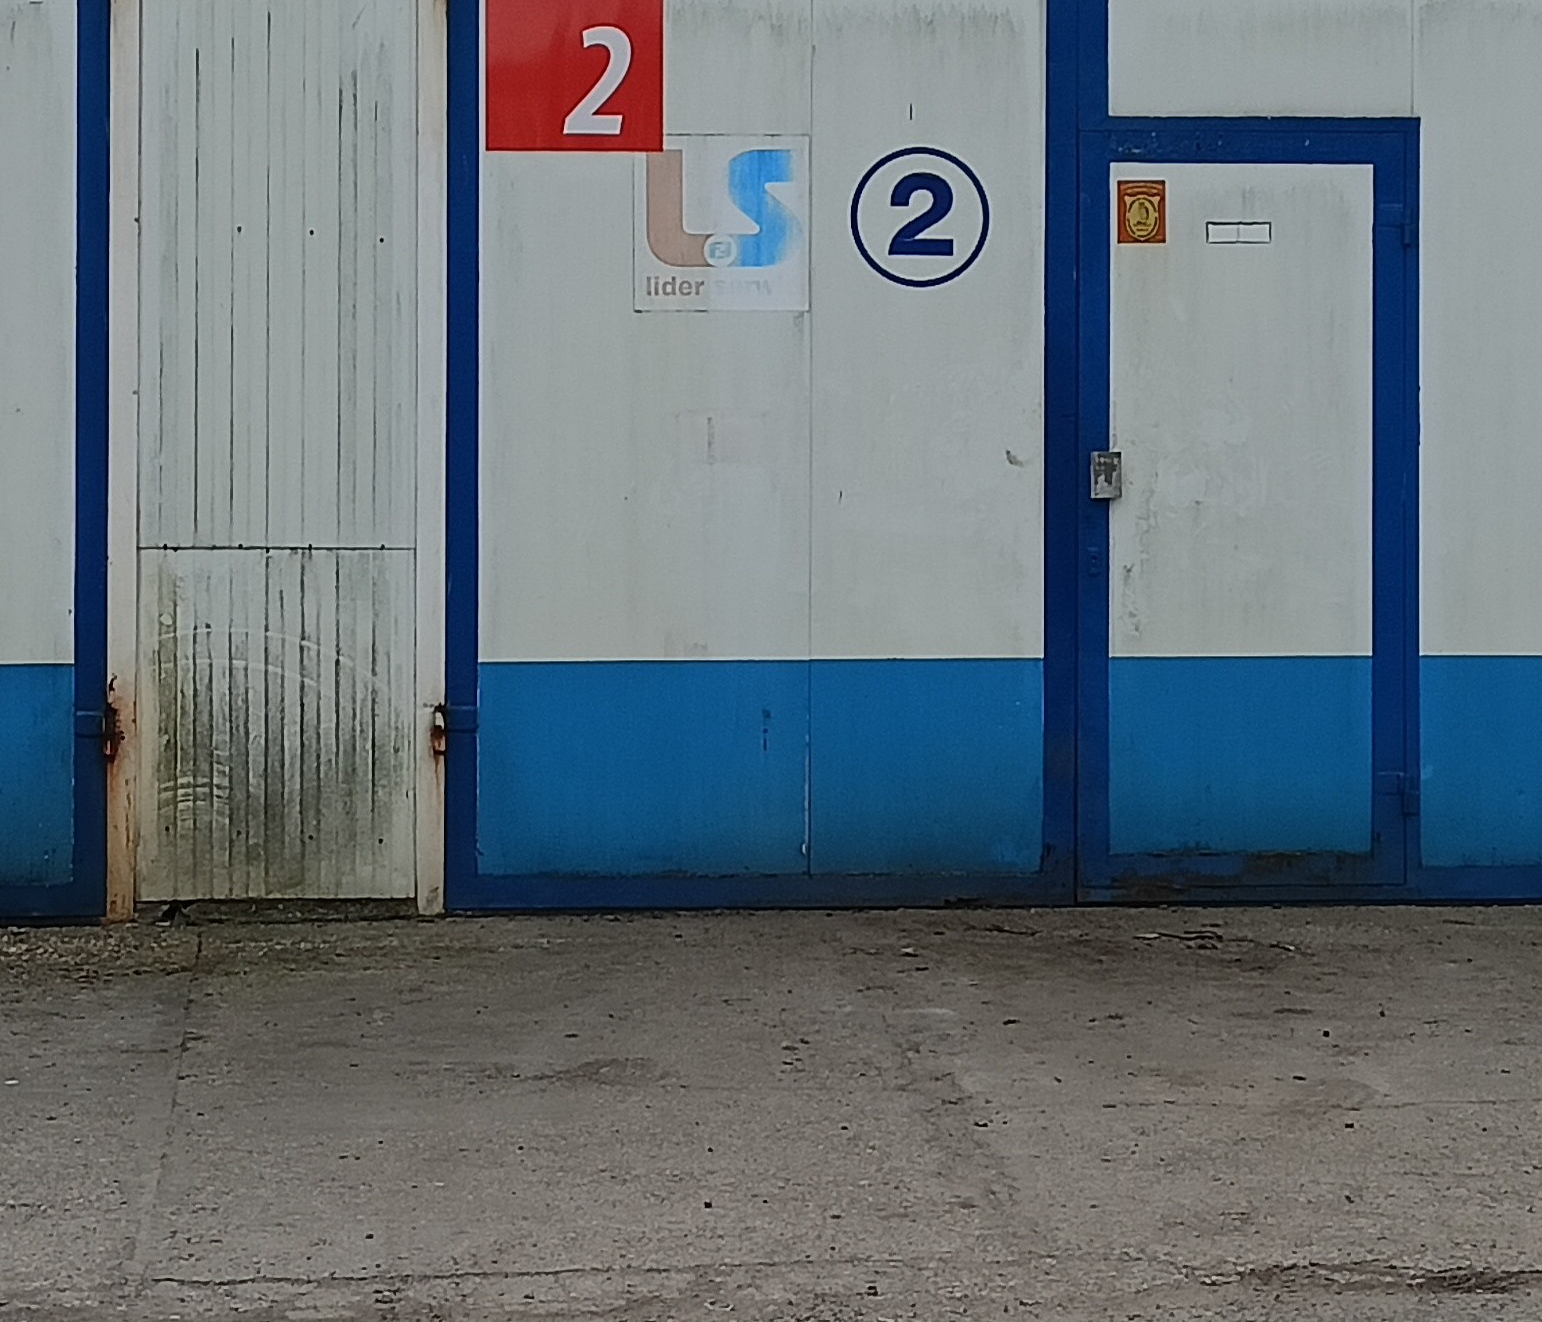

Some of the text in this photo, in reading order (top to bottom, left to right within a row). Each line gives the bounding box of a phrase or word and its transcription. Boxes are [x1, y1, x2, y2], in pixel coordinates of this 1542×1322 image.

[562, 24, 634, 136] 2
[887, 170, 955, 258] 2
[646, 275, 706, 297] lider
